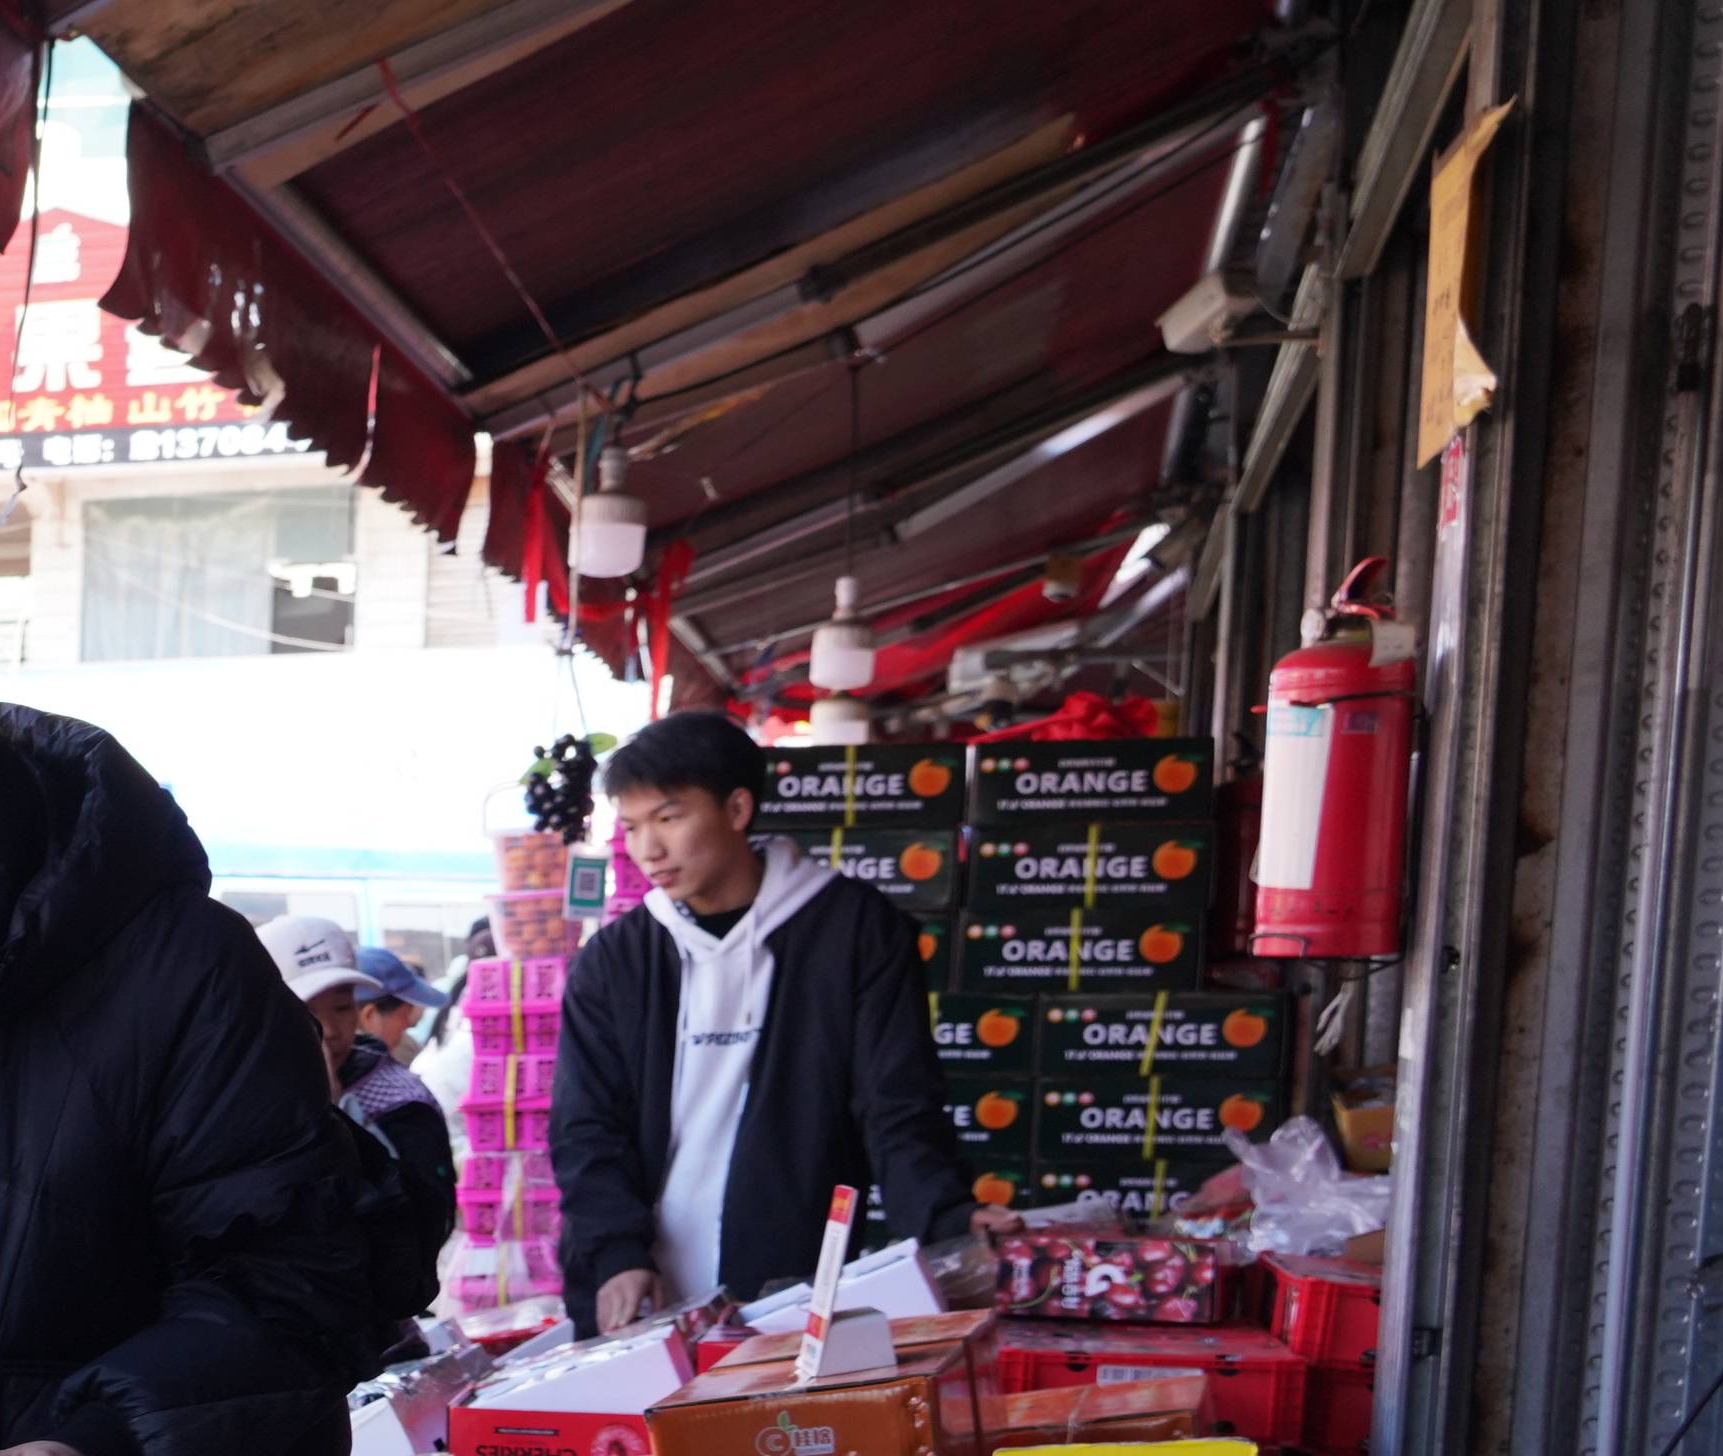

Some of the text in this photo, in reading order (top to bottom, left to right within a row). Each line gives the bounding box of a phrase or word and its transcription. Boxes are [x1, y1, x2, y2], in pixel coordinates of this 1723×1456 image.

[128, 387, 225, 424] 山竹
[777, 774, 906, 799] ORANGE
[1015, 769, 1149, 795] ORANGE
[1014, 856, 1149, 880] ORANGE
[1002, 939, 1134, 963] ORANGE
[1082, 1022, 1218, 1046] ORANGE
[1080, 1106, 1215, 1130] ORANGE
[1076, 1190, 1191, 1211] ORANG
